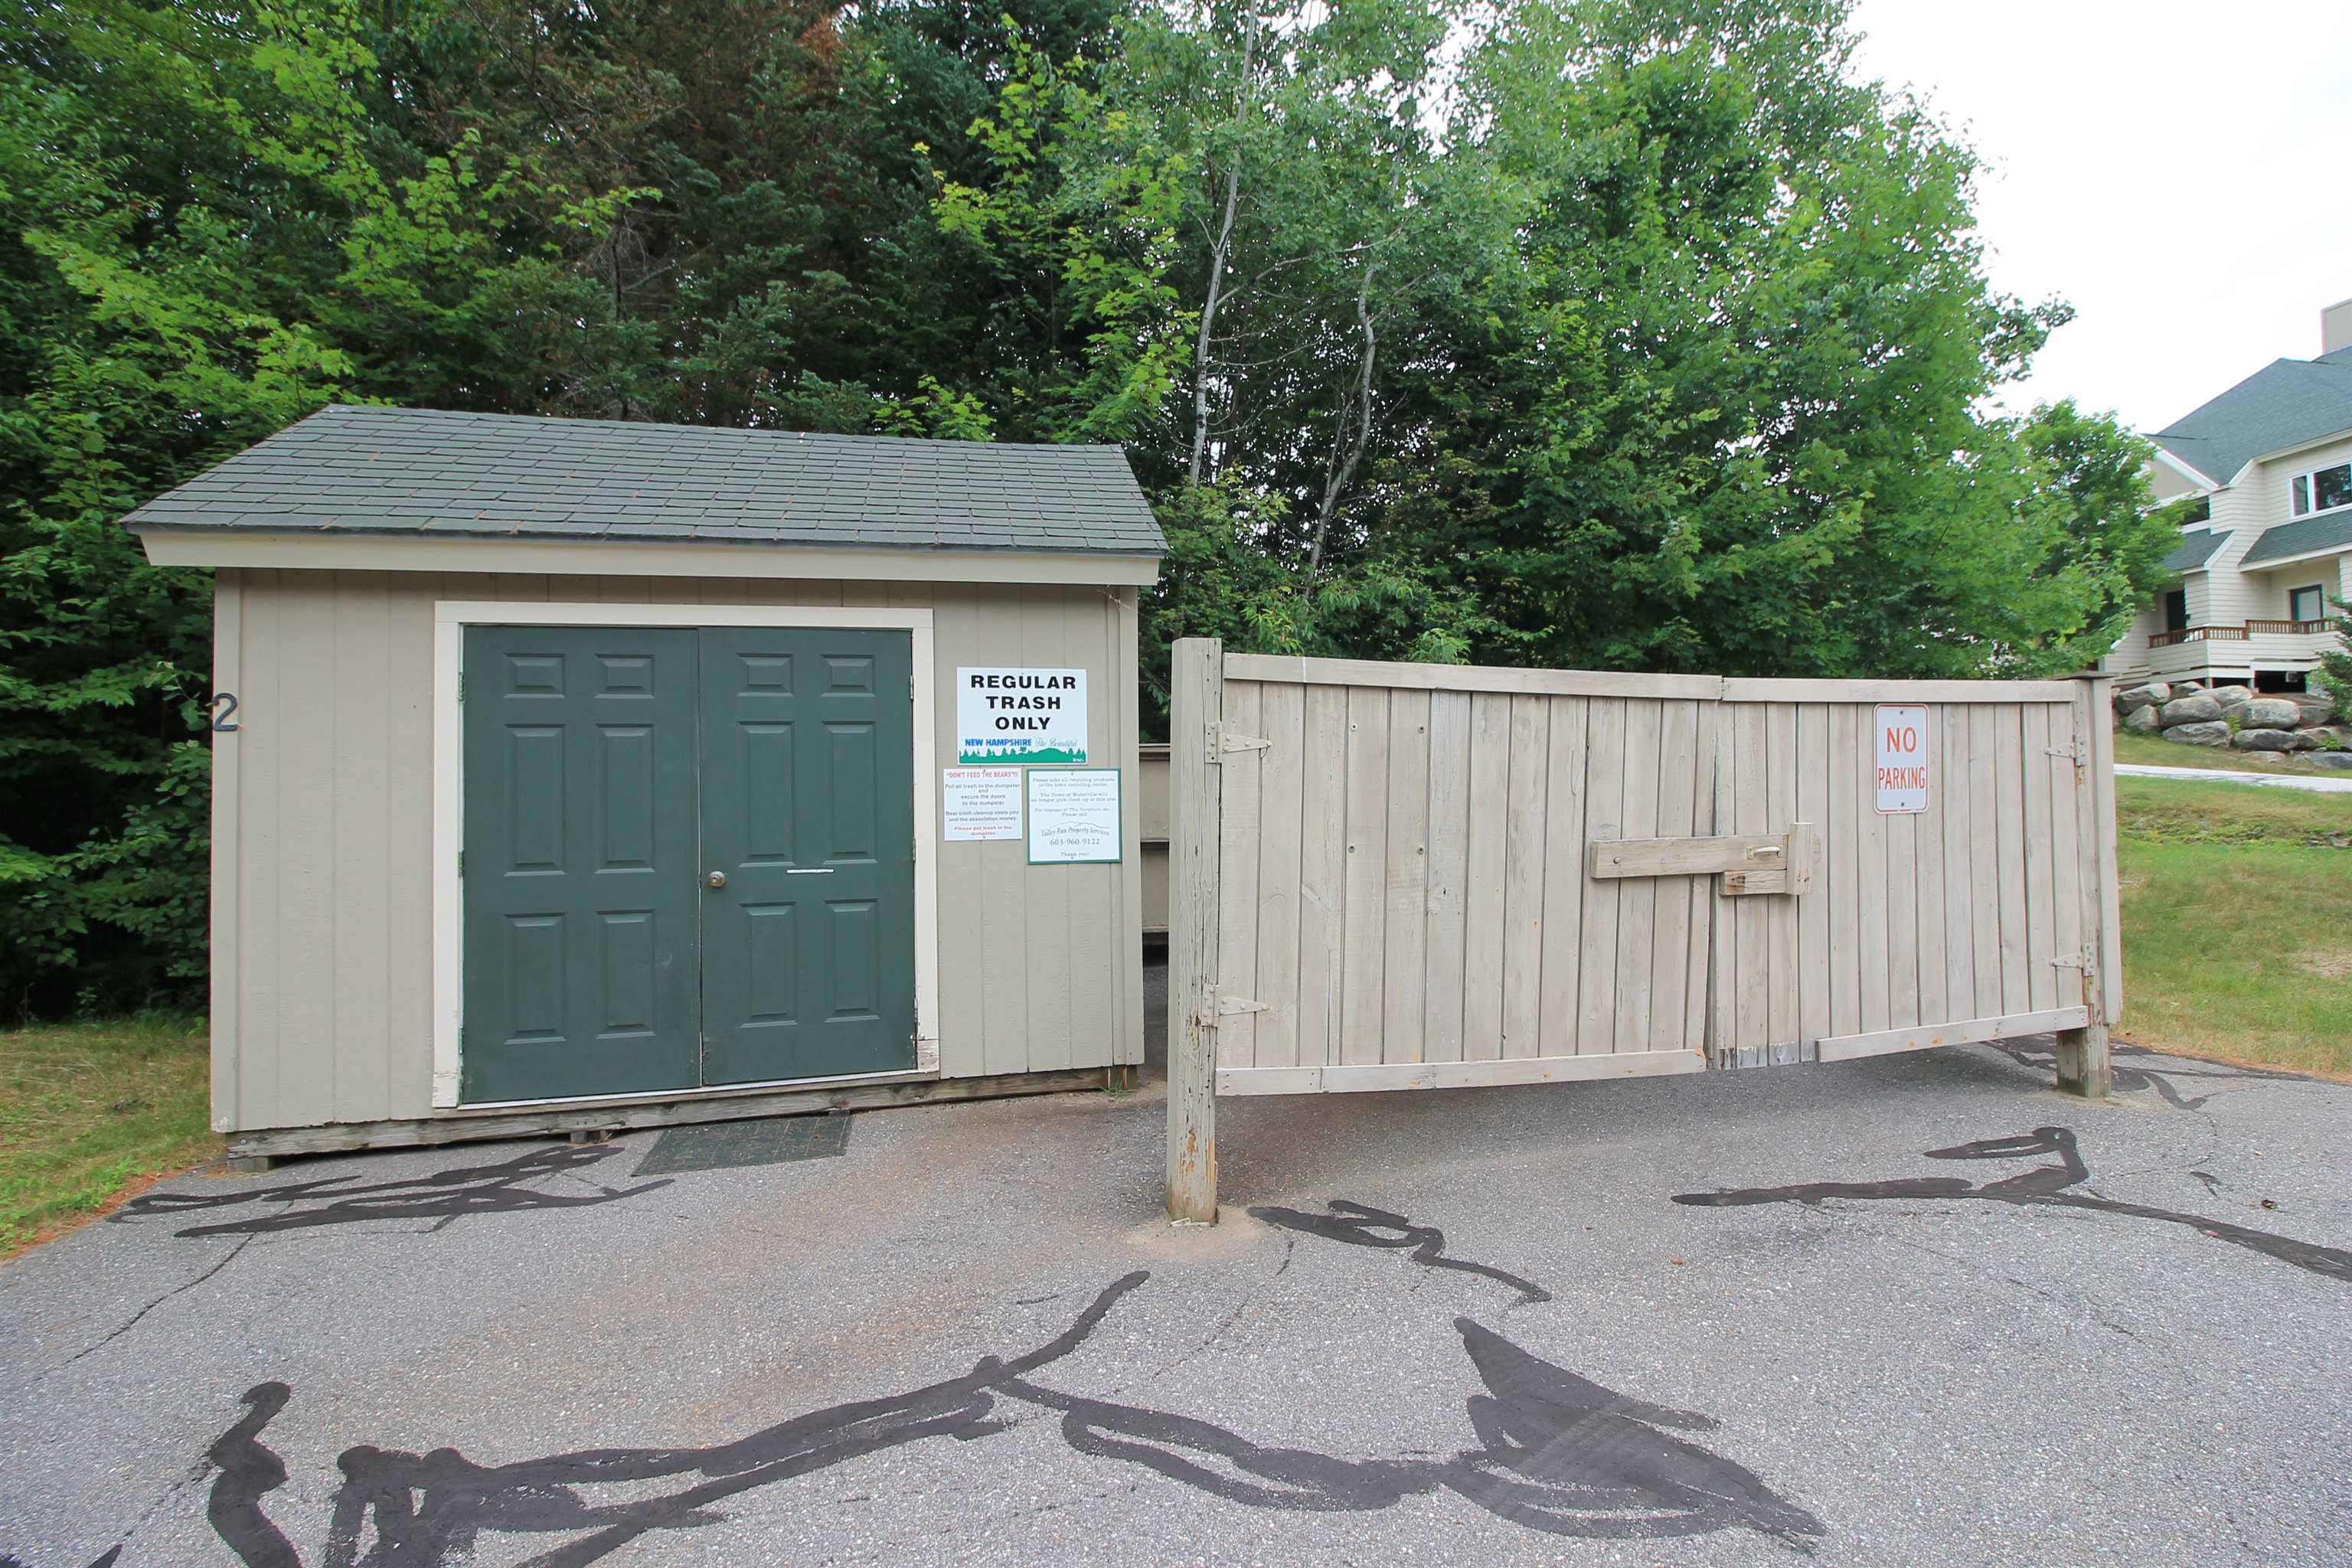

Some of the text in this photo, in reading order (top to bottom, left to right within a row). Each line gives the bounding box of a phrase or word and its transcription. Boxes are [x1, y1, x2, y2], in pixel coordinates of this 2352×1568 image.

[971, 675, 1076, 689] REGULAR
[986, 696, 1060, 709] TRASH
[211, 693, 239, 731] 2
[995, 717, 1050, 730] ONLY
[1034, 738, 1046, 747] The
[1049, 738, 1078, 747] Beautiful
[1887, 727, 1917, 753] NO
[1878, 767, 1925, 790] PARKING
[1041, 829, 1056, 837] Valley
[1068, 827, 1088, 835] Property
[1090, 828, 1109, 836] Services
